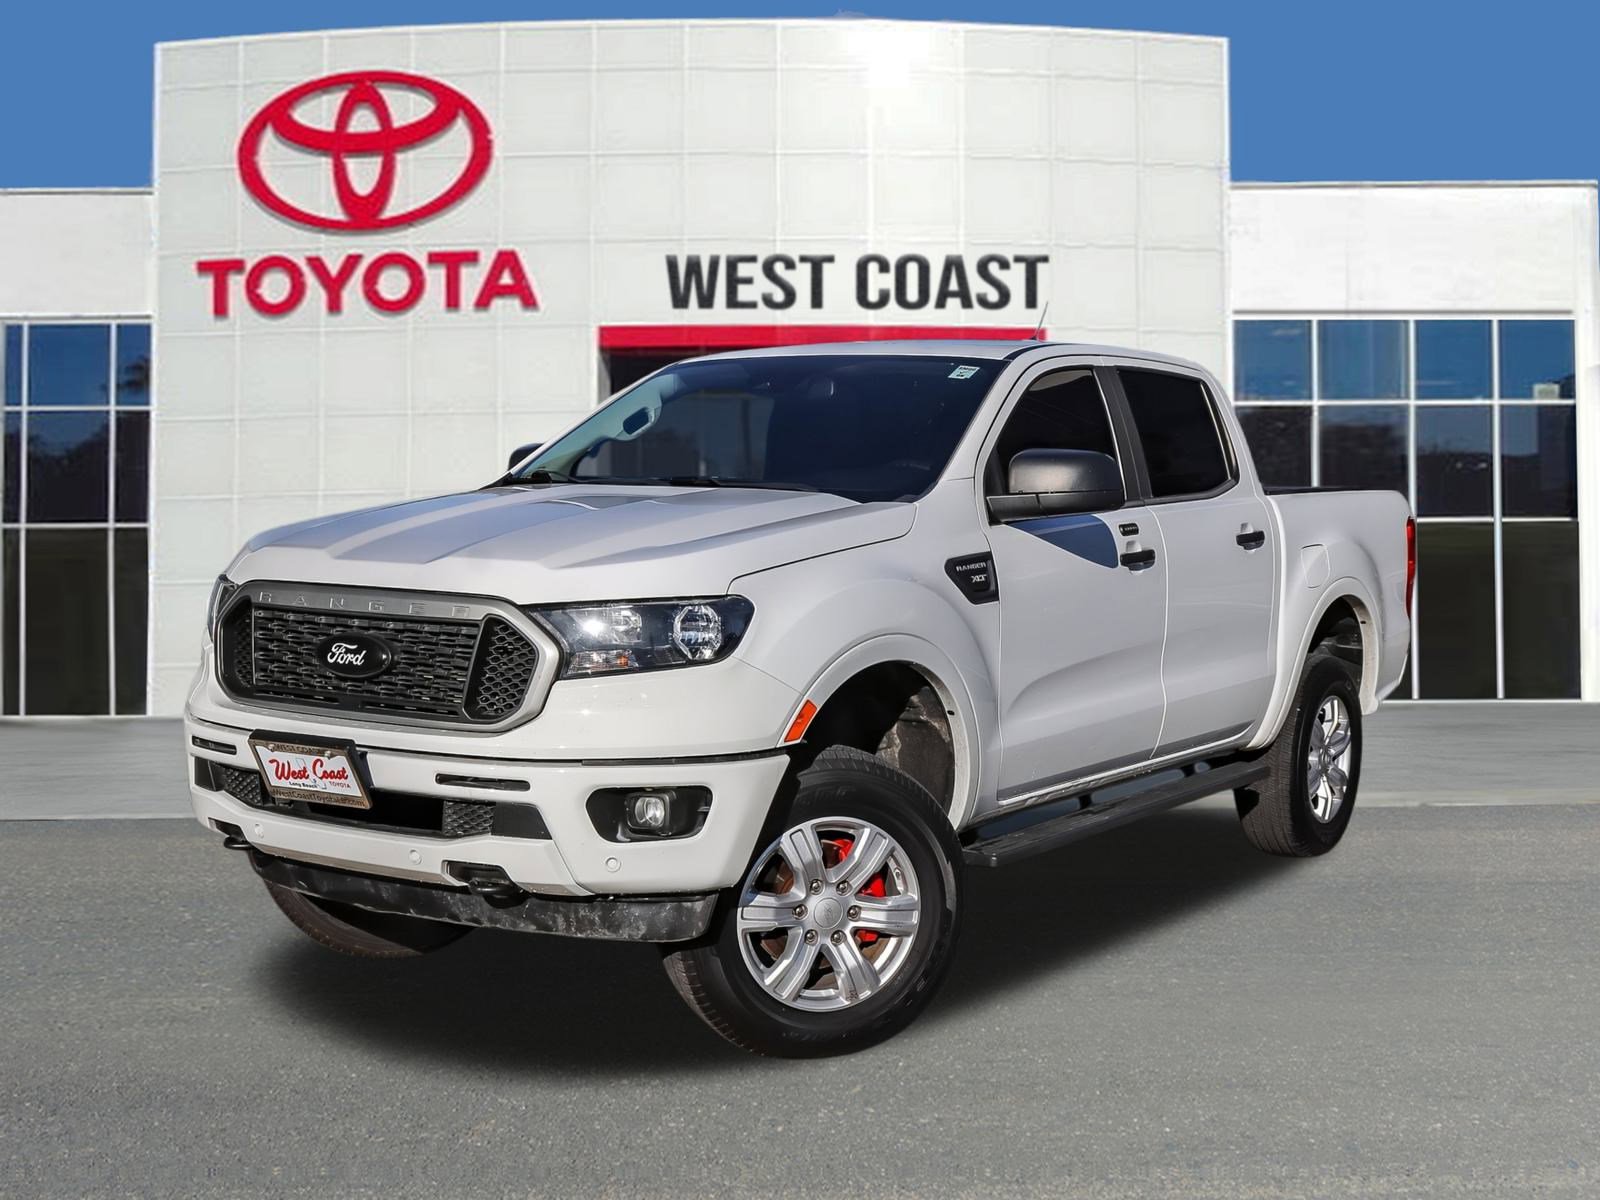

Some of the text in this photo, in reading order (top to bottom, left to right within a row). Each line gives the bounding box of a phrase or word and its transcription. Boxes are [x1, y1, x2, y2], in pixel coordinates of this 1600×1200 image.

[196, 250, 538, 317] TOYOTA
[665, 254, 1050, 310] WEST COAST
[955, 561, 987, 572] RANGER
[970, 574, 987, 583] XLT
[259, 591, 471, 617] RANGER
[327, 642, 366, 667] Ford
[268, 758, 348, 780] West Coast
[329, 781, 351, 789] TOYOTA
